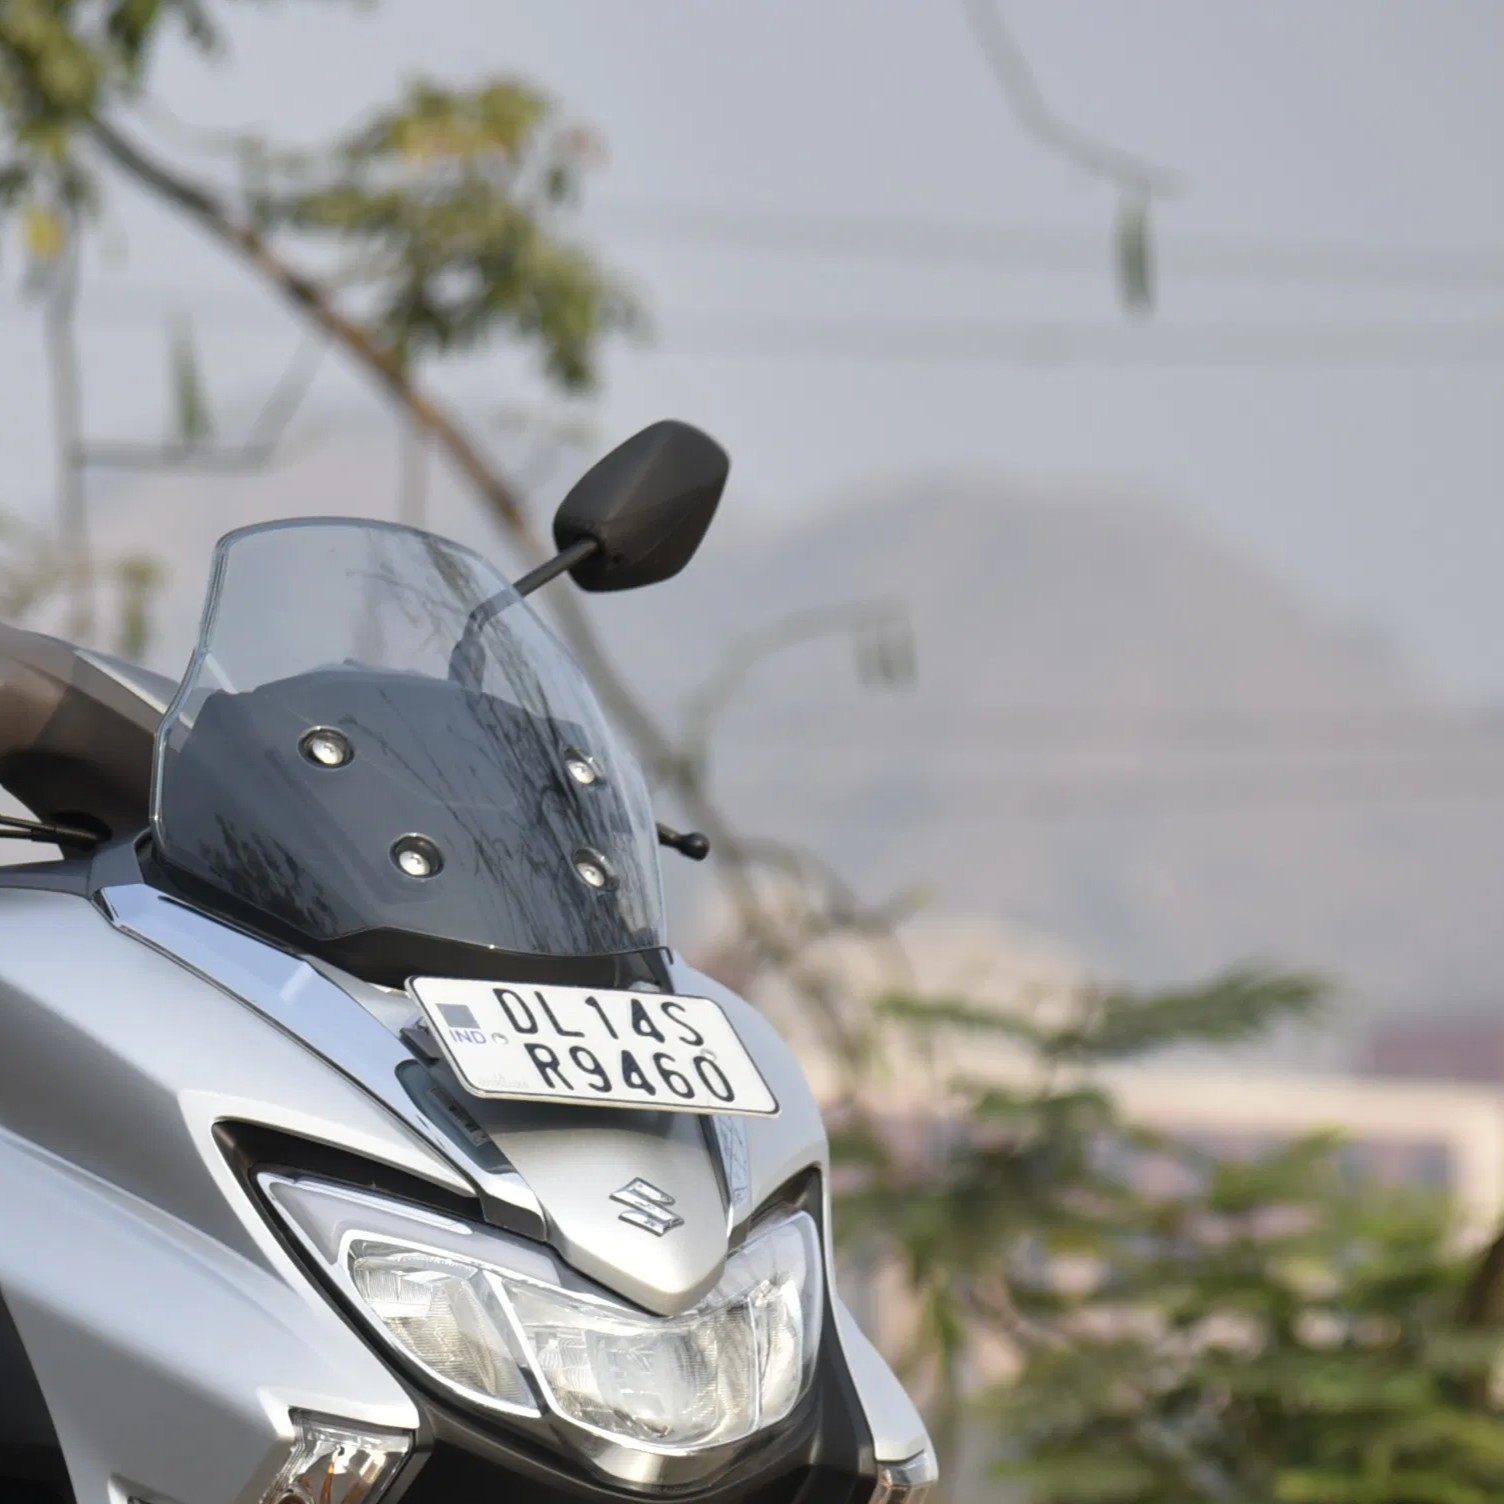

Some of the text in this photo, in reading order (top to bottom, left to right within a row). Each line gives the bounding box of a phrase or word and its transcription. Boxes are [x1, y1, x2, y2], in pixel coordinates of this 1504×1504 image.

[449, 1029, 487, 1044] IND
[492, 987, 704, 1047] DL14S
[524, 1042, 736, 1102] R9460
